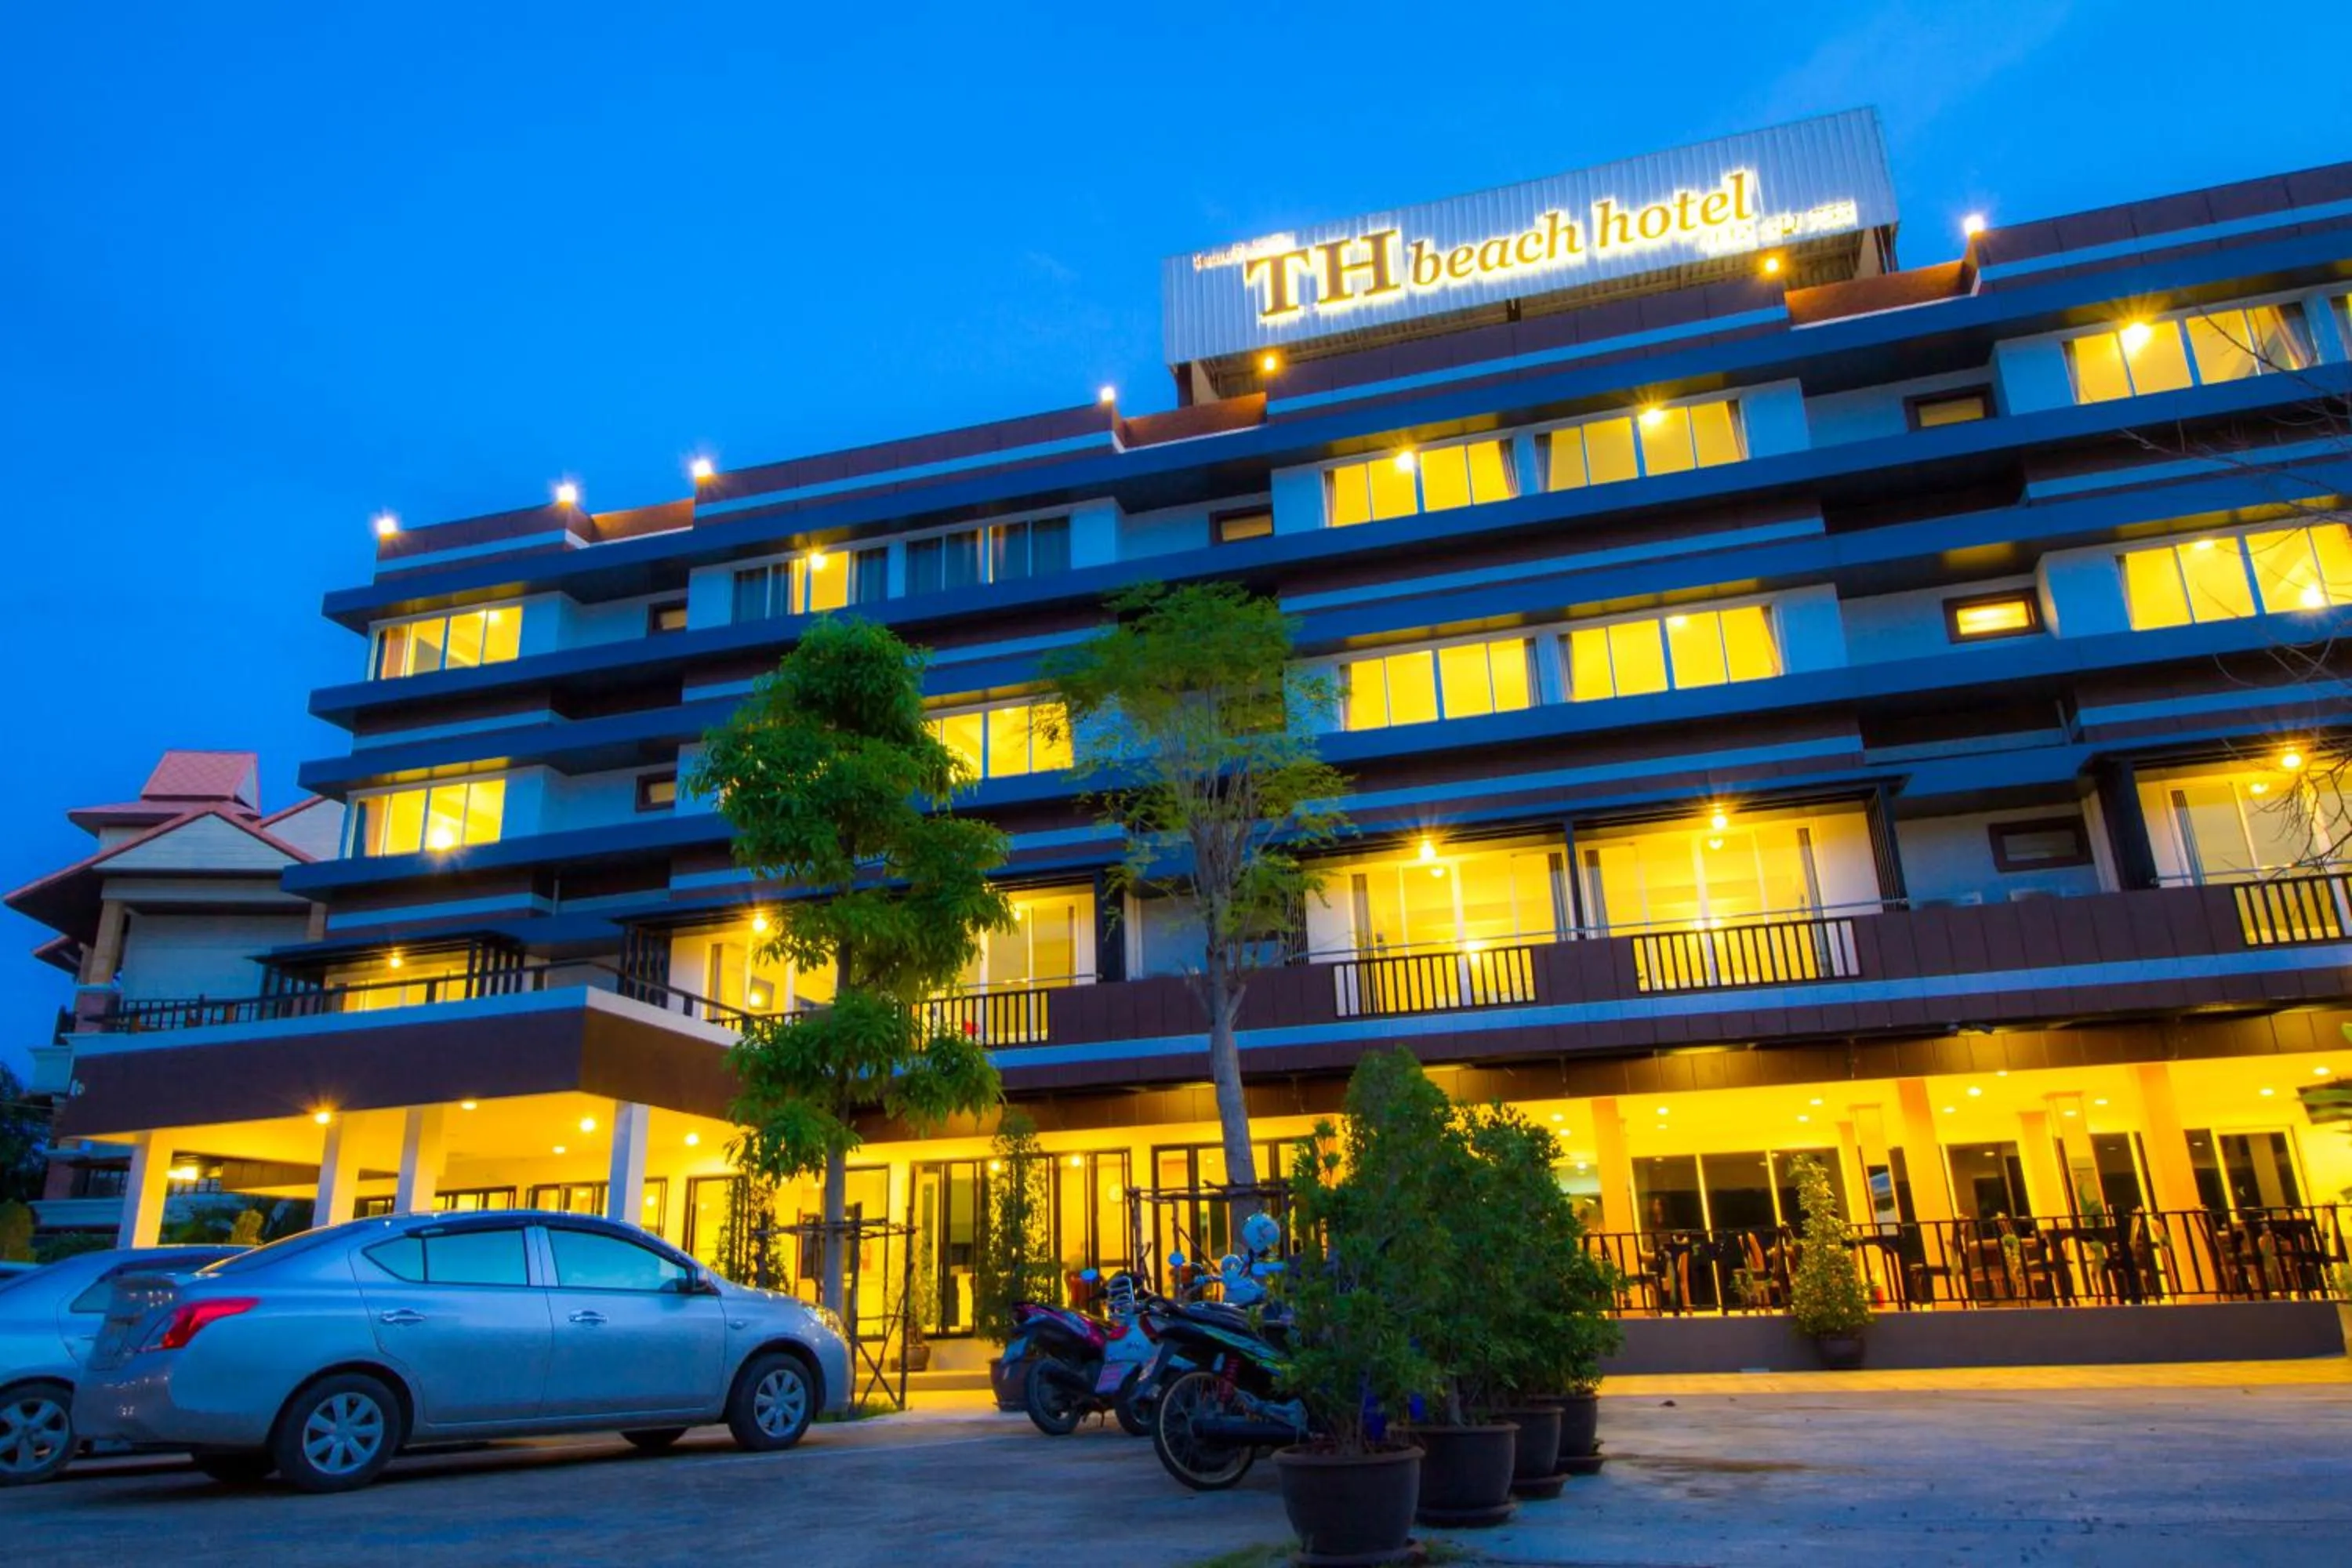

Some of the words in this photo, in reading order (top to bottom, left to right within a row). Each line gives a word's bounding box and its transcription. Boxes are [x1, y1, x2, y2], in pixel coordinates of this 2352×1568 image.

[1246, 229, 1400, 318] TH
[1410, 212, 1582, 285] beach
[1595, 172, 1751, 248] hotel
